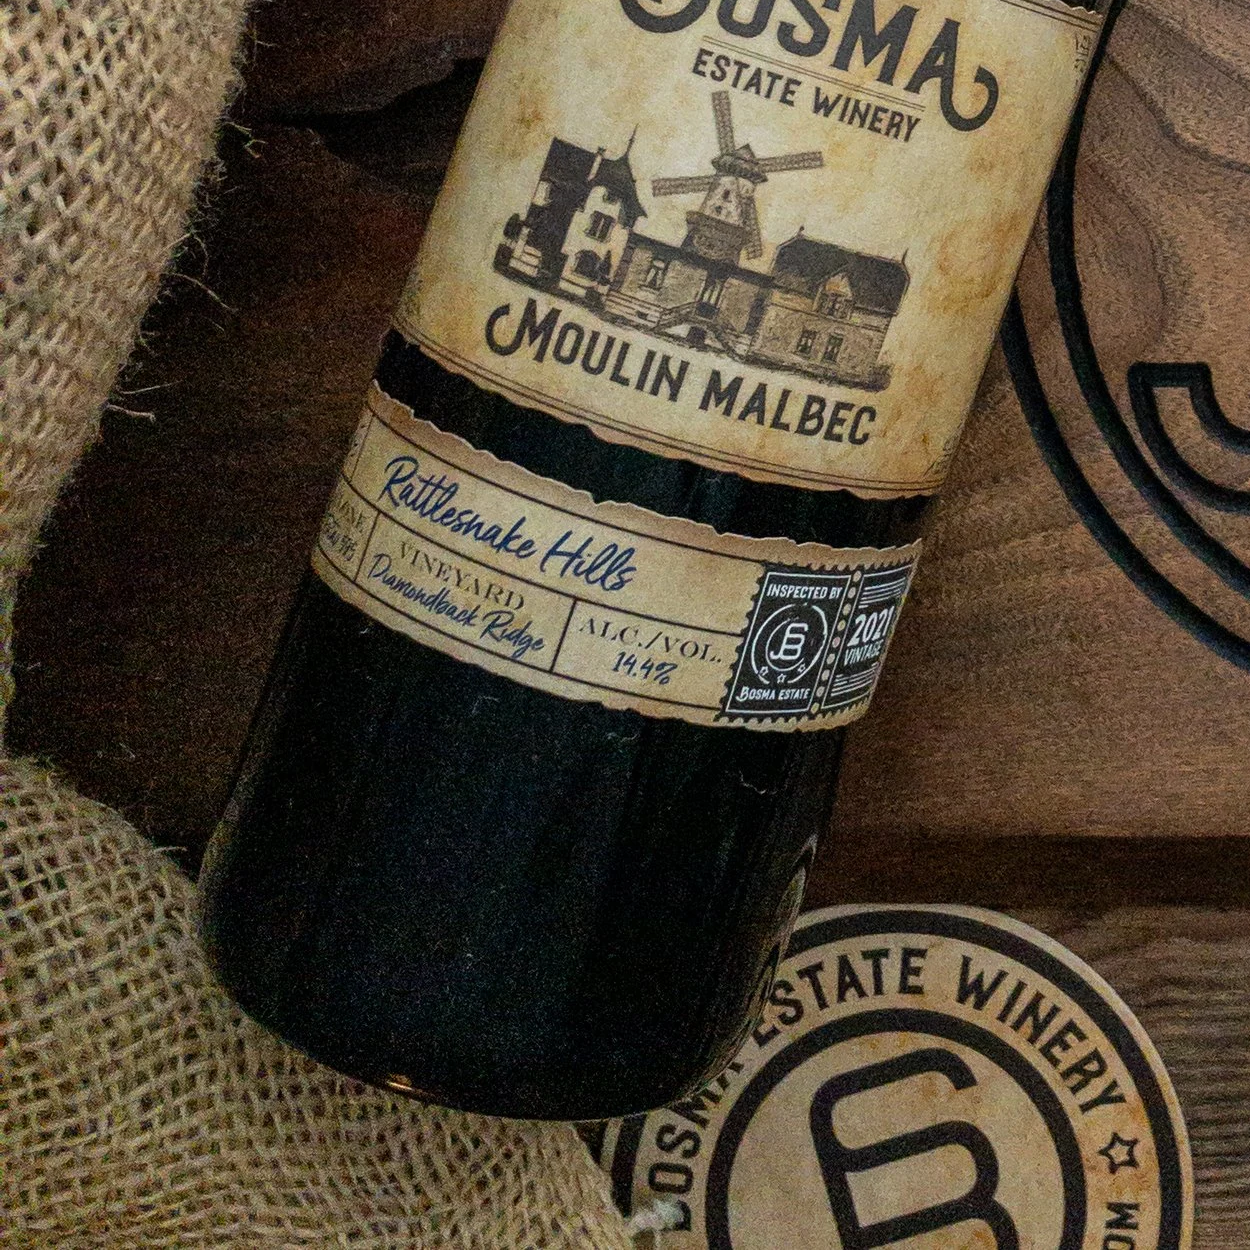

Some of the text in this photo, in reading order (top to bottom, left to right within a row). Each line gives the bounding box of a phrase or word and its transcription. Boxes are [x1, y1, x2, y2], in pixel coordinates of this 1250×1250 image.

[692, 48, 922, 143] ESTATE WINERY
[485, 297, 877, 446] MOULIN MALBEC
[378, 455, 537, 559] Rattlesnake
[539, 530, 637, 592] Hills
[368, 553, 545, 660] Diamondback Ridge
[399, 540, 525, 611] VINEYARD
[766, 583, 843, 600] INSPECTED BY
[612, 650, 679, 685] 14.4%
[847, 605, 895, 647] 2021
[735, 686, 812, 704] BOSMA ESTATE
[649, 1062, 745, 1232] OSM
[954, 953, 1128, 1115] WINERY
